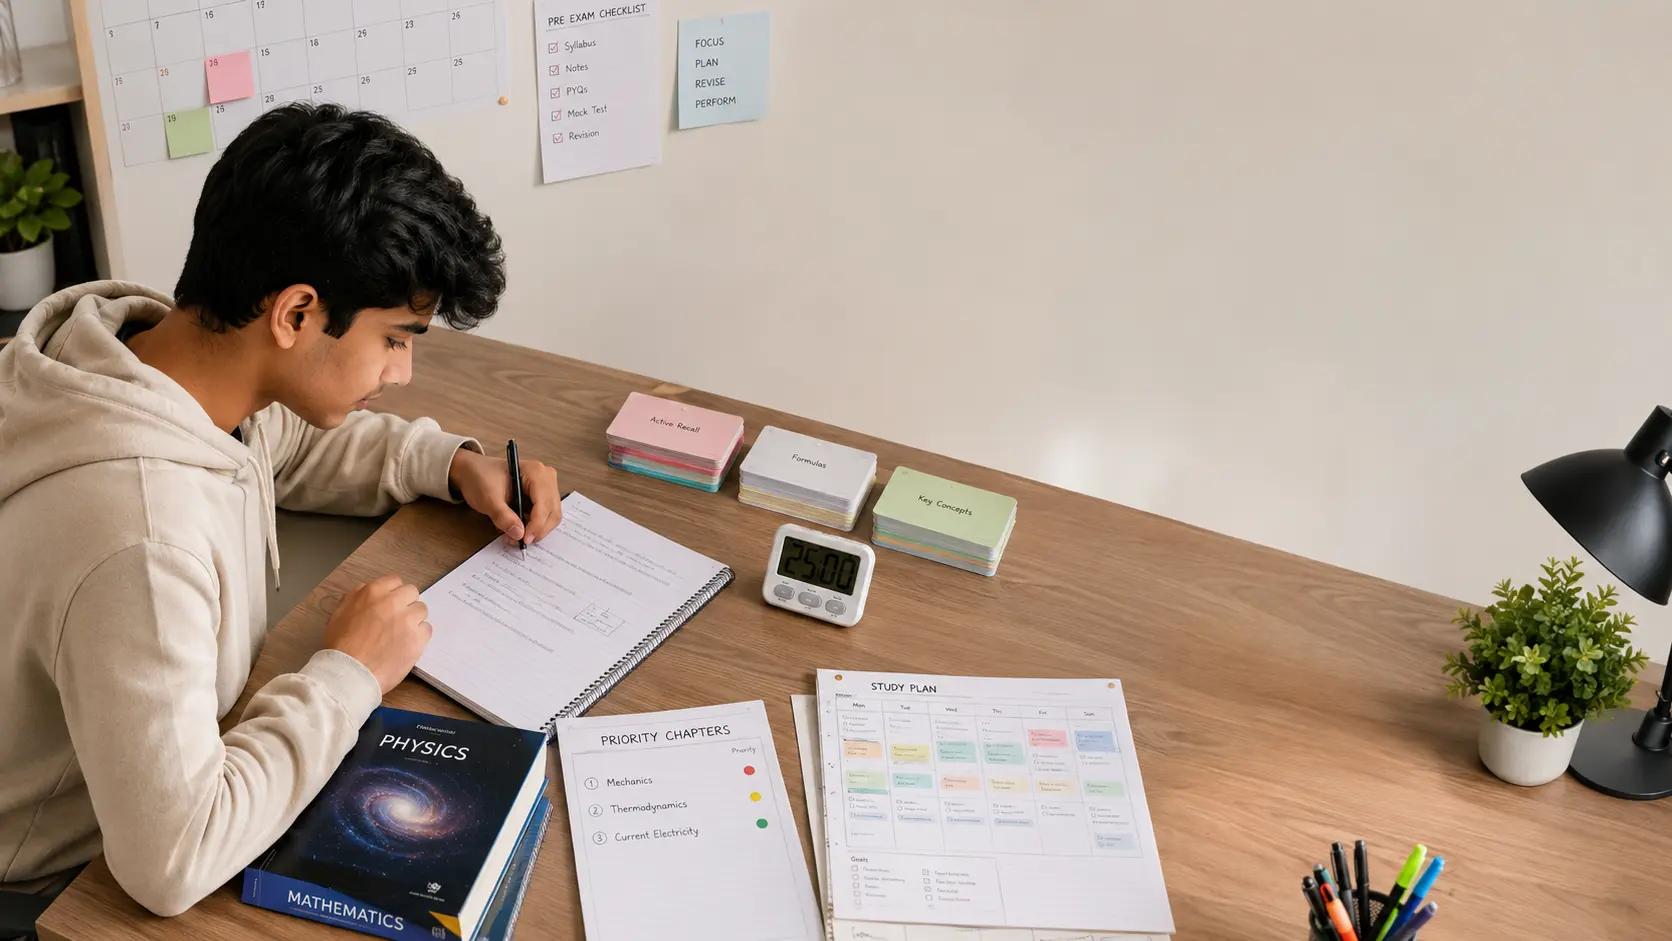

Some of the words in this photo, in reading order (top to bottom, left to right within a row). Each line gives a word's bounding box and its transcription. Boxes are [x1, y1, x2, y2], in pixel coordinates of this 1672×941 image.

[548, 16, 565, 27] PRE
[569, 11, 595, 24] EXAM
[599, 3, 646, 19] CHECKLIST
[564, 39, 597, 53] Syllabus
[695, 37, 725, 48] FOCUS
[565, 64, 589, 74] Notes
[695, 58, 719, 69] PLAN
[695, 77, 726, 88] REVISE
[566, 86, 588, 96] PYQs
[695, 96, 737, 109] PERFORM
[567, 108, 588, 118] Mock
[591, 104, 608, 114] Test
[569, 130, 600, 141] Revision
[650, 415, 674, 428] Active
[676, 421, 700, 434] Recall
[791, 453, 827, 470] Formulas
[918, 494, 934, 508] Key
[936, 499, 973, 517] Concepts
[785, 540, 857, 592] 25:00
[871, 682, 905, 692] STUDY
[910, 684, 937, 694] PLAN
[601, 731, 658, 746] PRIORITY
[665, 725, 731, 741] CHAPTERS
[379, 734, 470, 761] PHYSICS
[731, 746, 757, 755] Priority
[606, 777, 653, 787] Mechanics
[610, 801, 688, 814] Thermodynamics
[614, 832, 650, 842] Current
[653, 827, 699, 840] Electricity
[287, 890, 405, 931] MATHEMATICS
